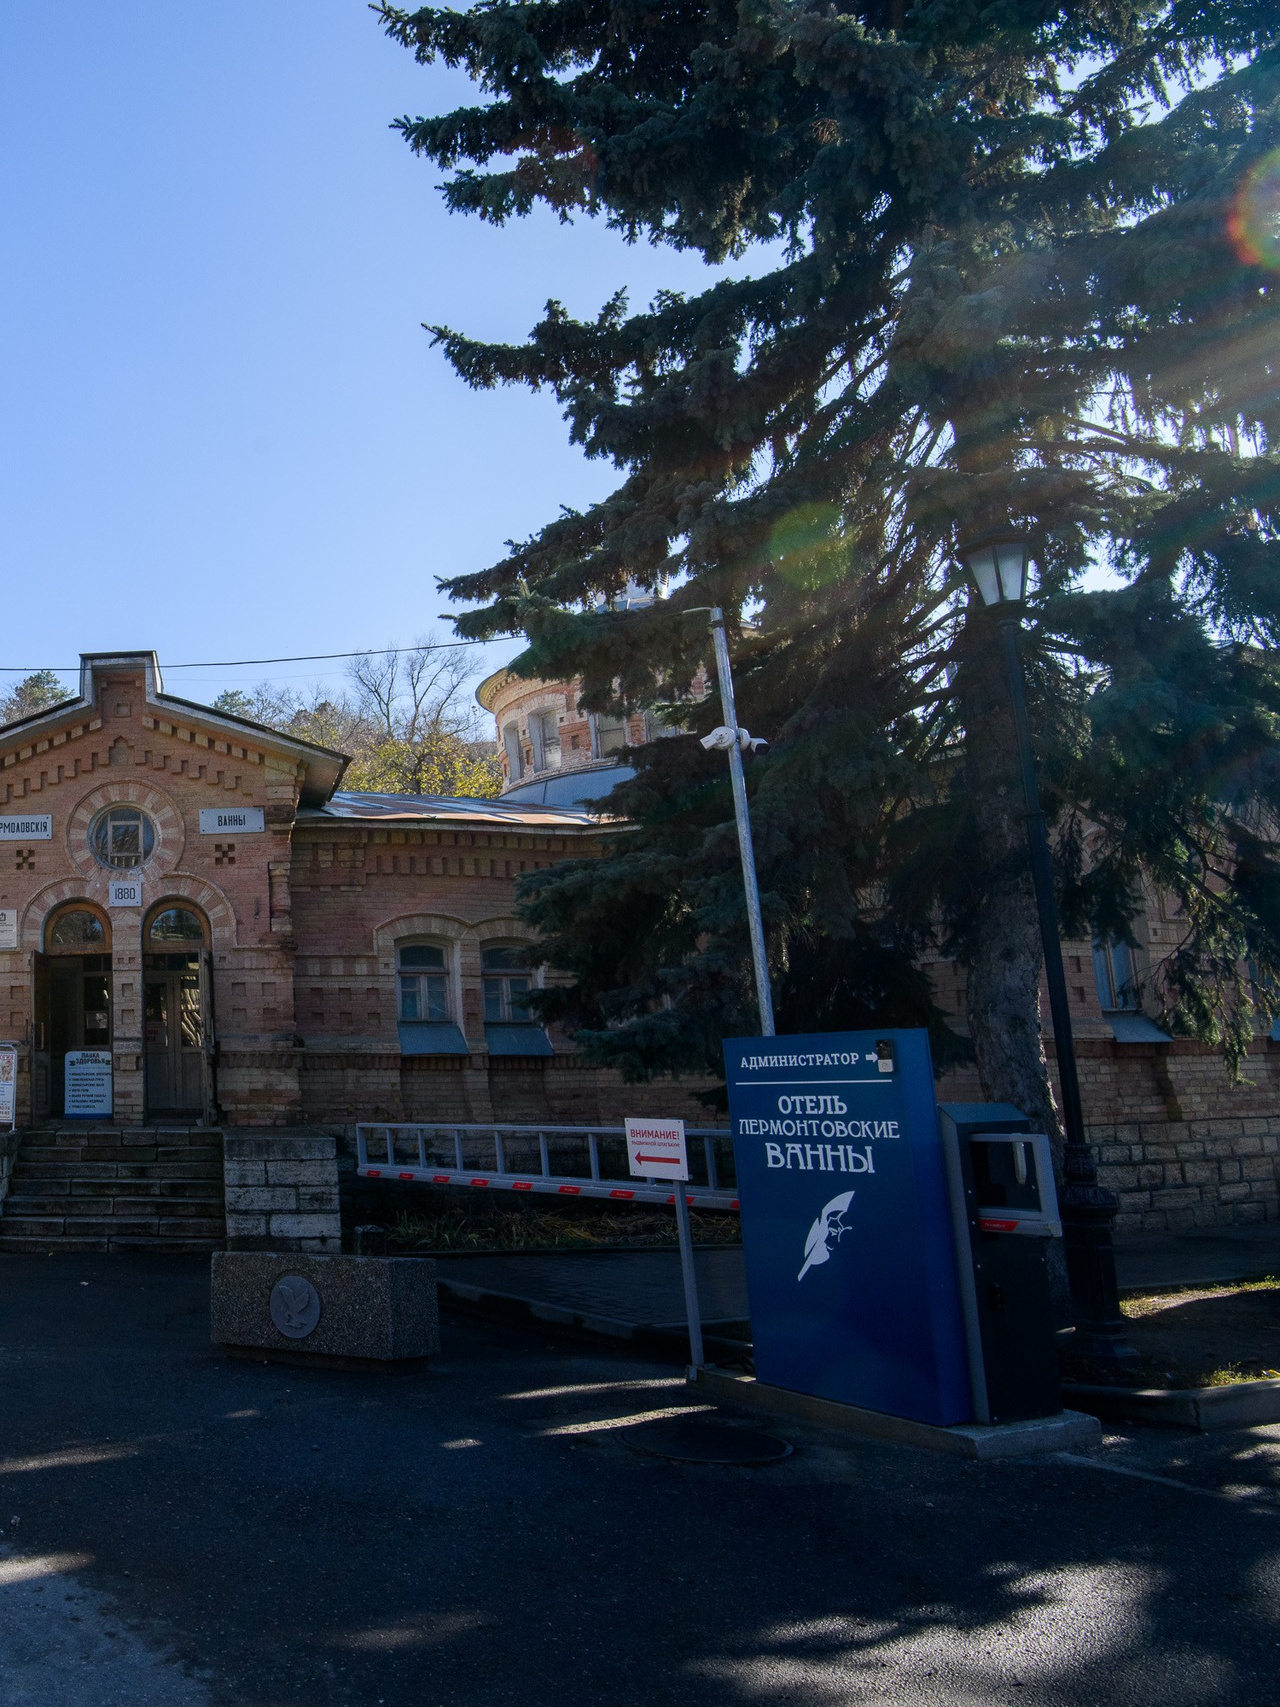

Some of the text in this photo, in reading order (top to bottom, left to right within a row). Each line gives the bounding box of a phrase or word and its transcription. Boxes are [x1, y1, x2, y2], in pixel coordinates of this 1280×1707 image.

[217, 814, 247, 827] ВАННЫ
[114, 888, 136, 900] 1880
[740, 1052, 860, 1070] АДМИНИСТРАТОР
[778, 1095, 848, 1115] ОТЕЛЬ
[631, 1129, 680, 1140] ВНИМАНИЕ!
[739, 1119, 901, 1140] ЛЕРМОНТОВСКИЕ
[765, 1141, 876, 1174] ВАННЫ
